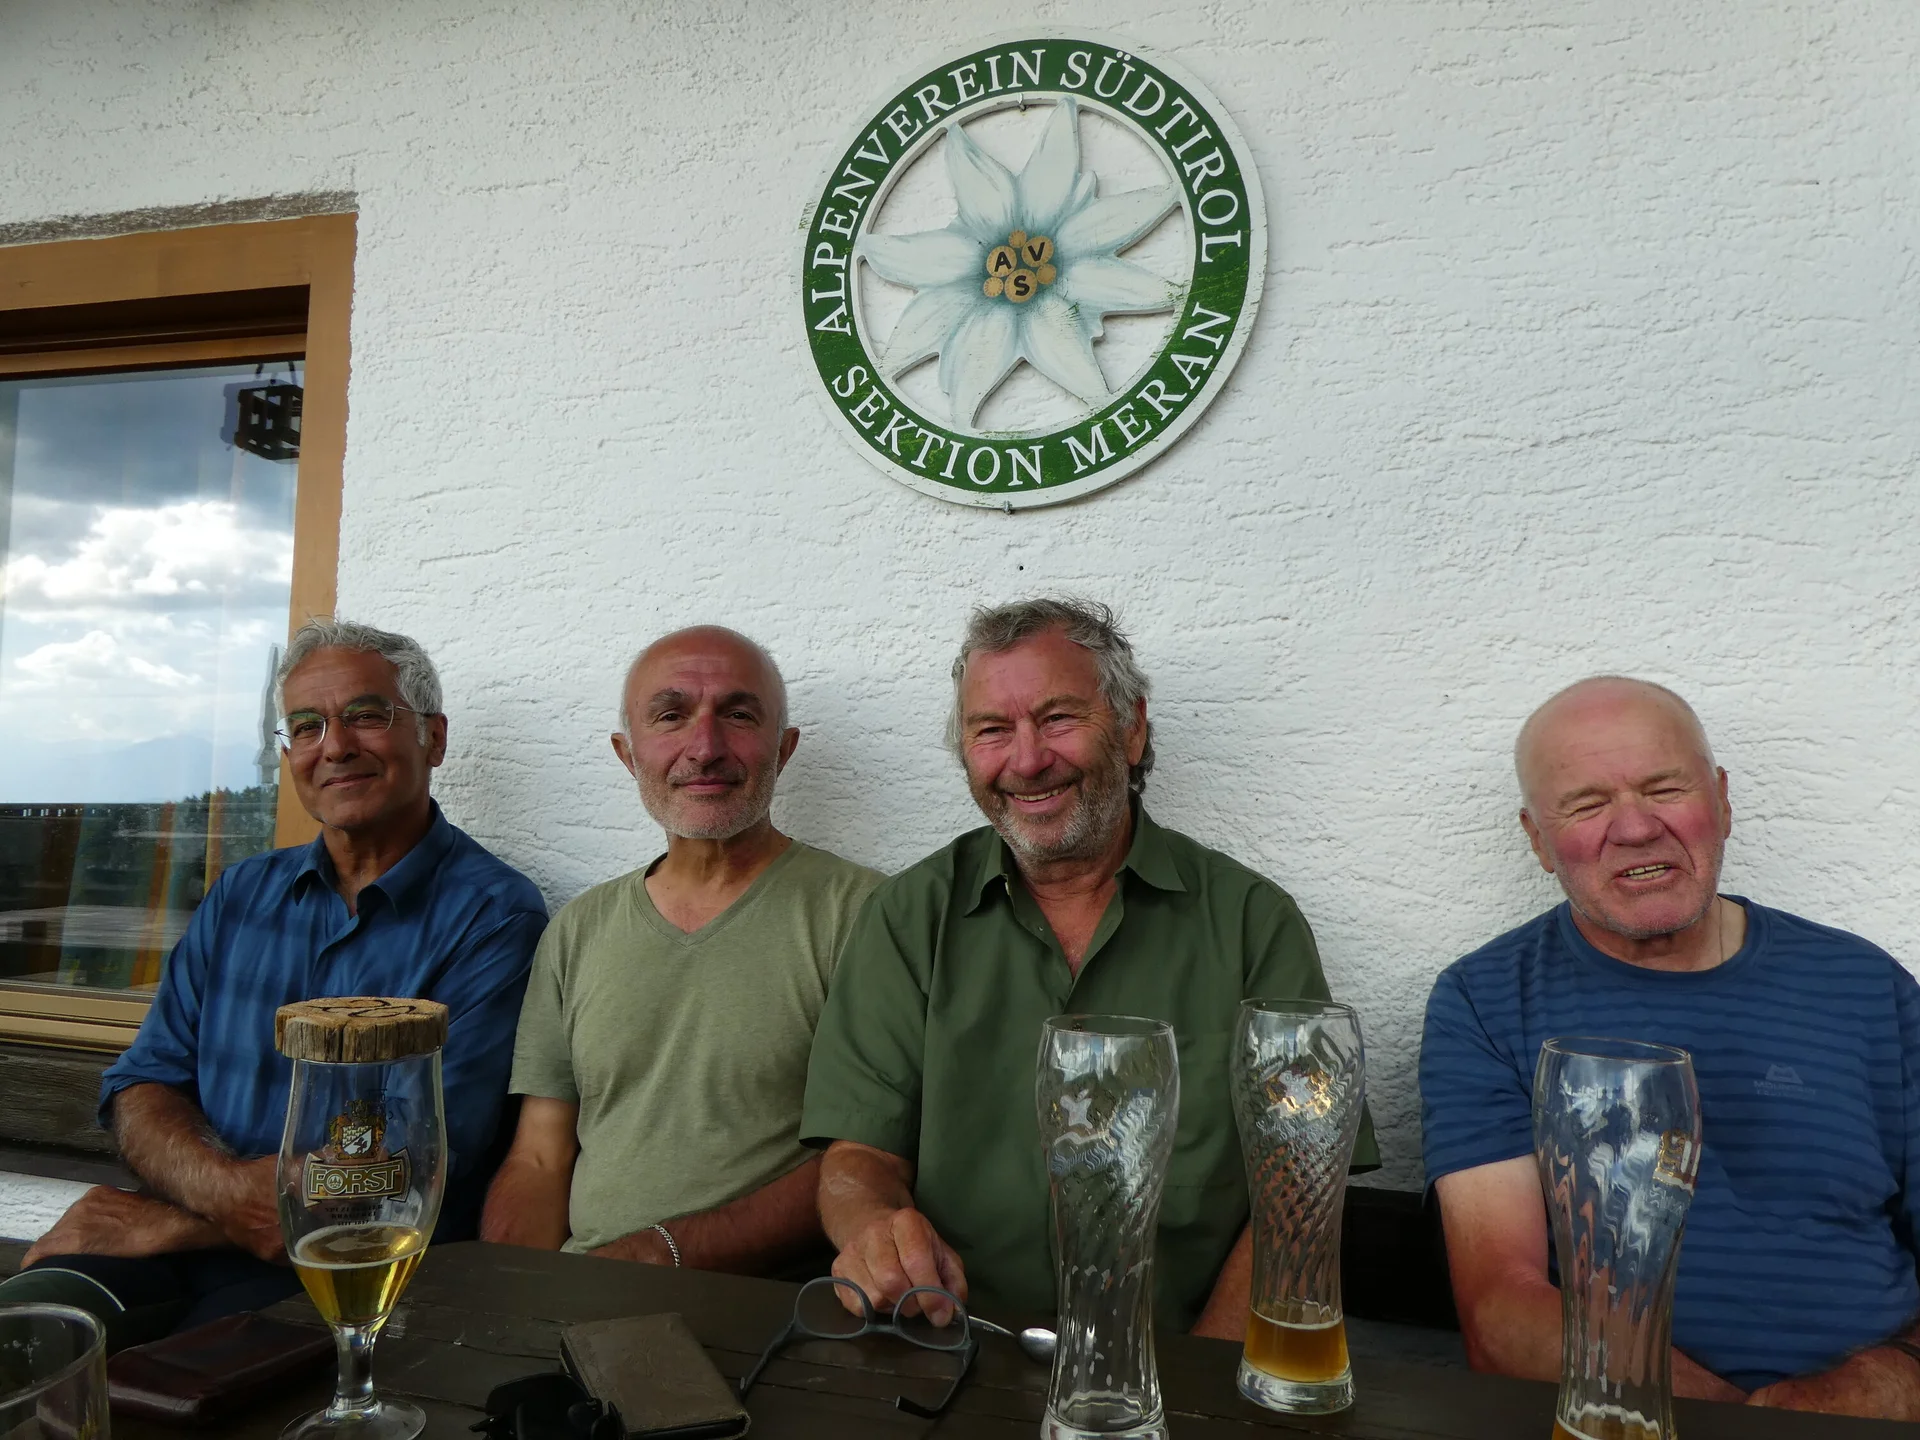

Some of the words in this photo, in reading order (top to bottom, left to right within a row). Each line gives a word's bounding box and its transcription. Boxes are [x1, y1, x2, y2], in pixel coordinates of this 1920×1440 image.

[812, 48, 1047, 336] ALPENVEREIN
[1060, 50, 1241, 263] SÜDTIROL
[832, 364, 1044, 487] SEKTION
[1061, 301, 1232, 475] MERAN
[310, 1164, 400, 1195] FORST
